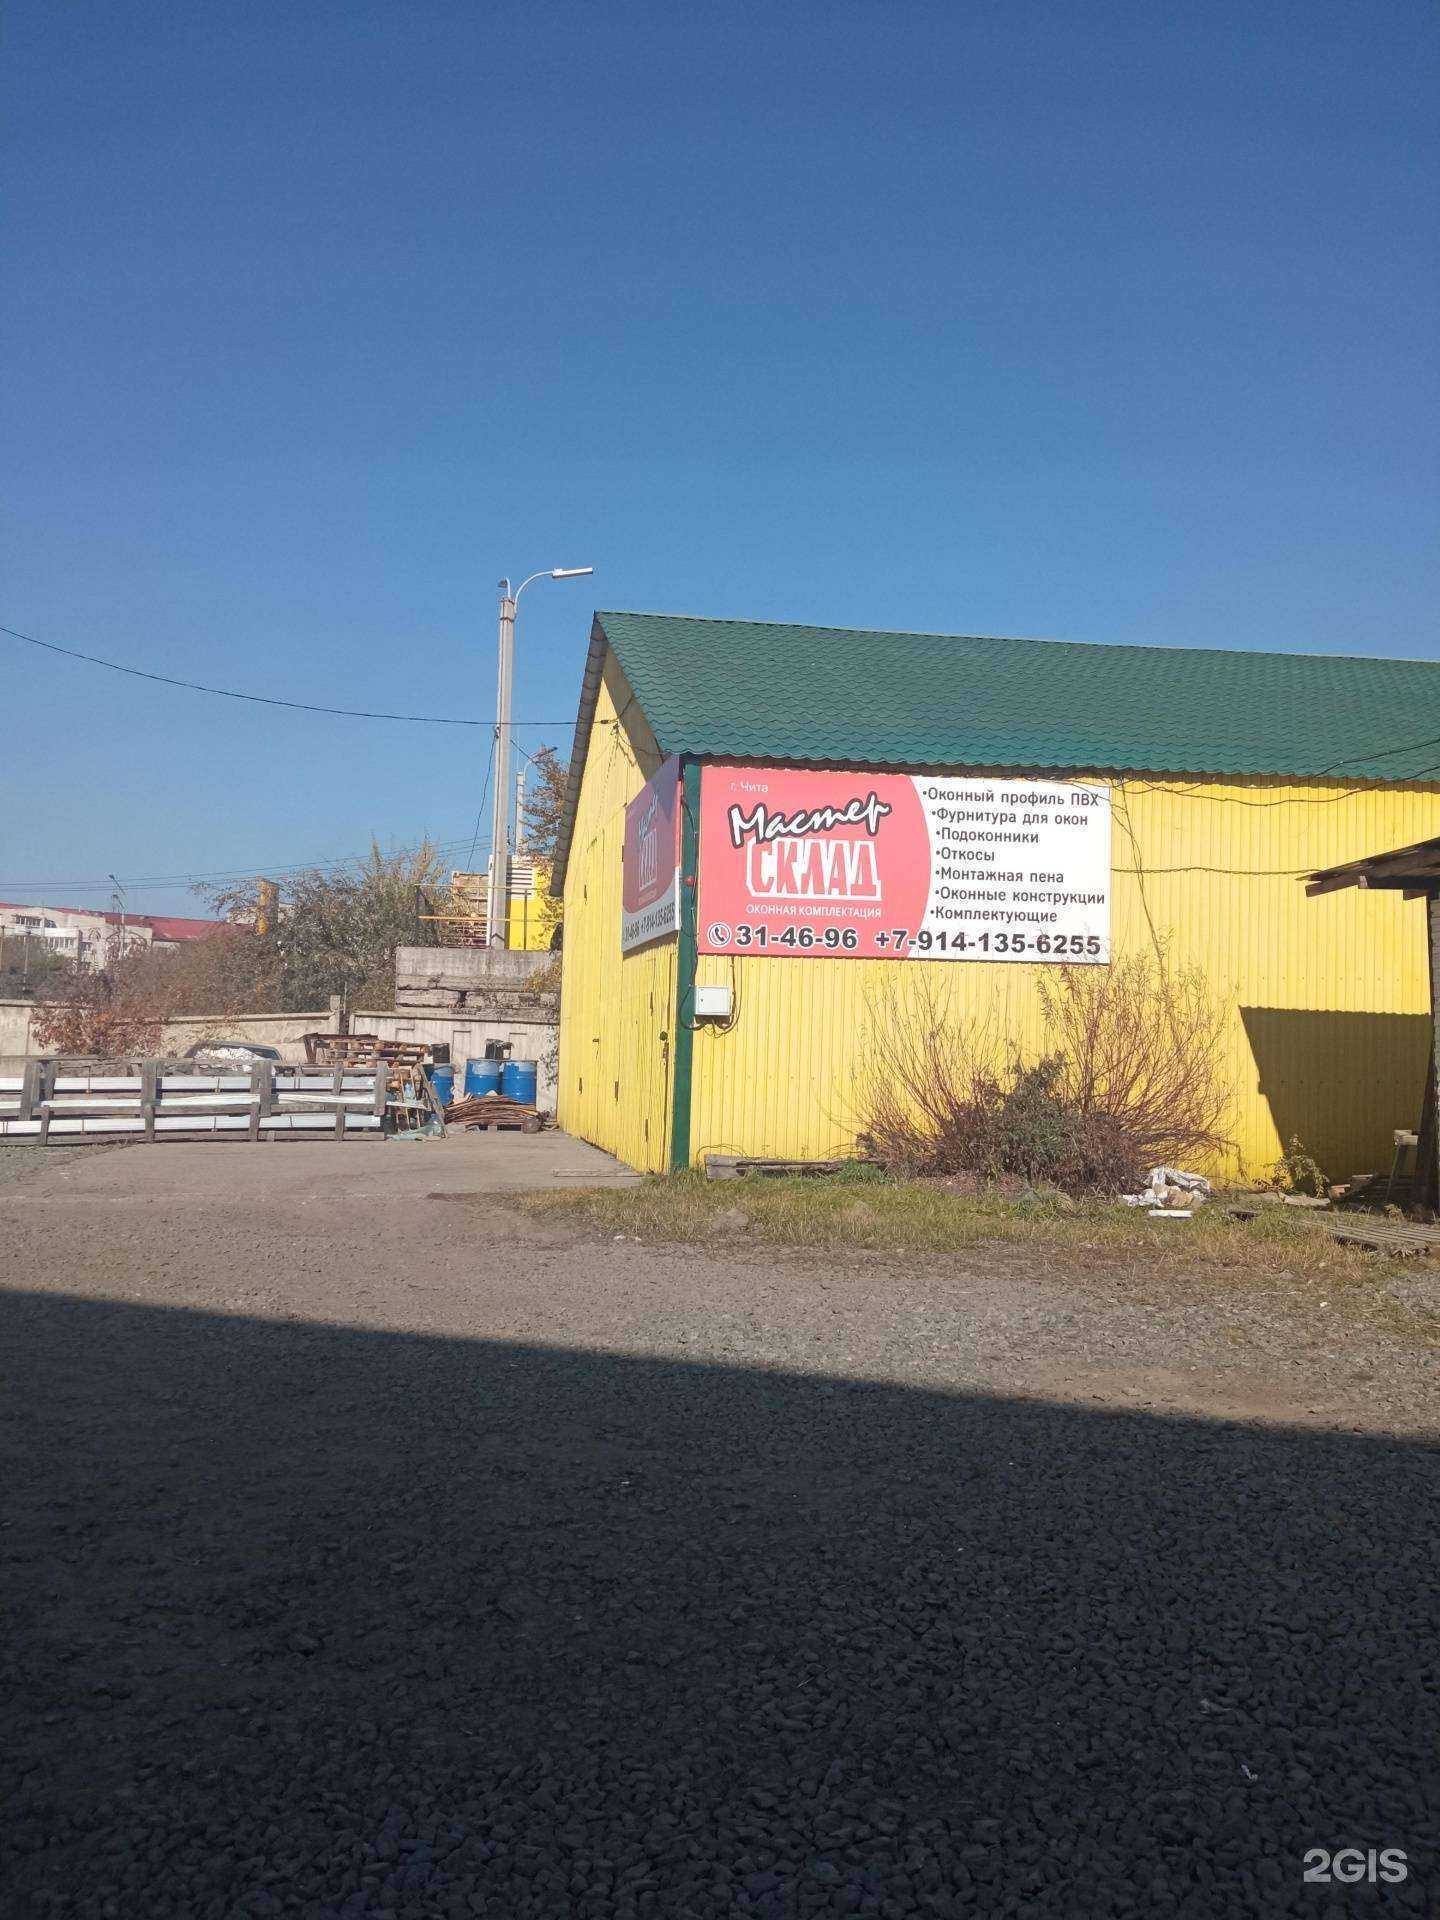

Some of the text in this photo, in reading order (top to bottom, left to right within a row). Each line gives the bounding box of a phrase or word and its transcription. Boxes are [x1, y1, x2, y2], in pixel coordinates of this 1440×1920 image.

[741, 782, 769, 793] Чита
[928, 787, 1099, 808] Оконный профиль ПВХ
[727, 791, 892, 848] Мастер
[936, 807, 1088, 825] Фурнитура для окон
[941, 827, 1039, 843] Подоконники
[941, 847, 995, 861] Откосы
[746, 836, 883, 900] СКЛАД
[941, 867, 1064, 883] Монтажная пена
[940, 886, 1105, 906] Оконные конструкции
[746, 903, 882, 919] ОКОННАЯ КОМПЛЕКТАЦИЯ
[935, 906, 1057, 923] Комплектующие
[736, 925, 1101, 955] 31-46-96 +7-914-135-6255
